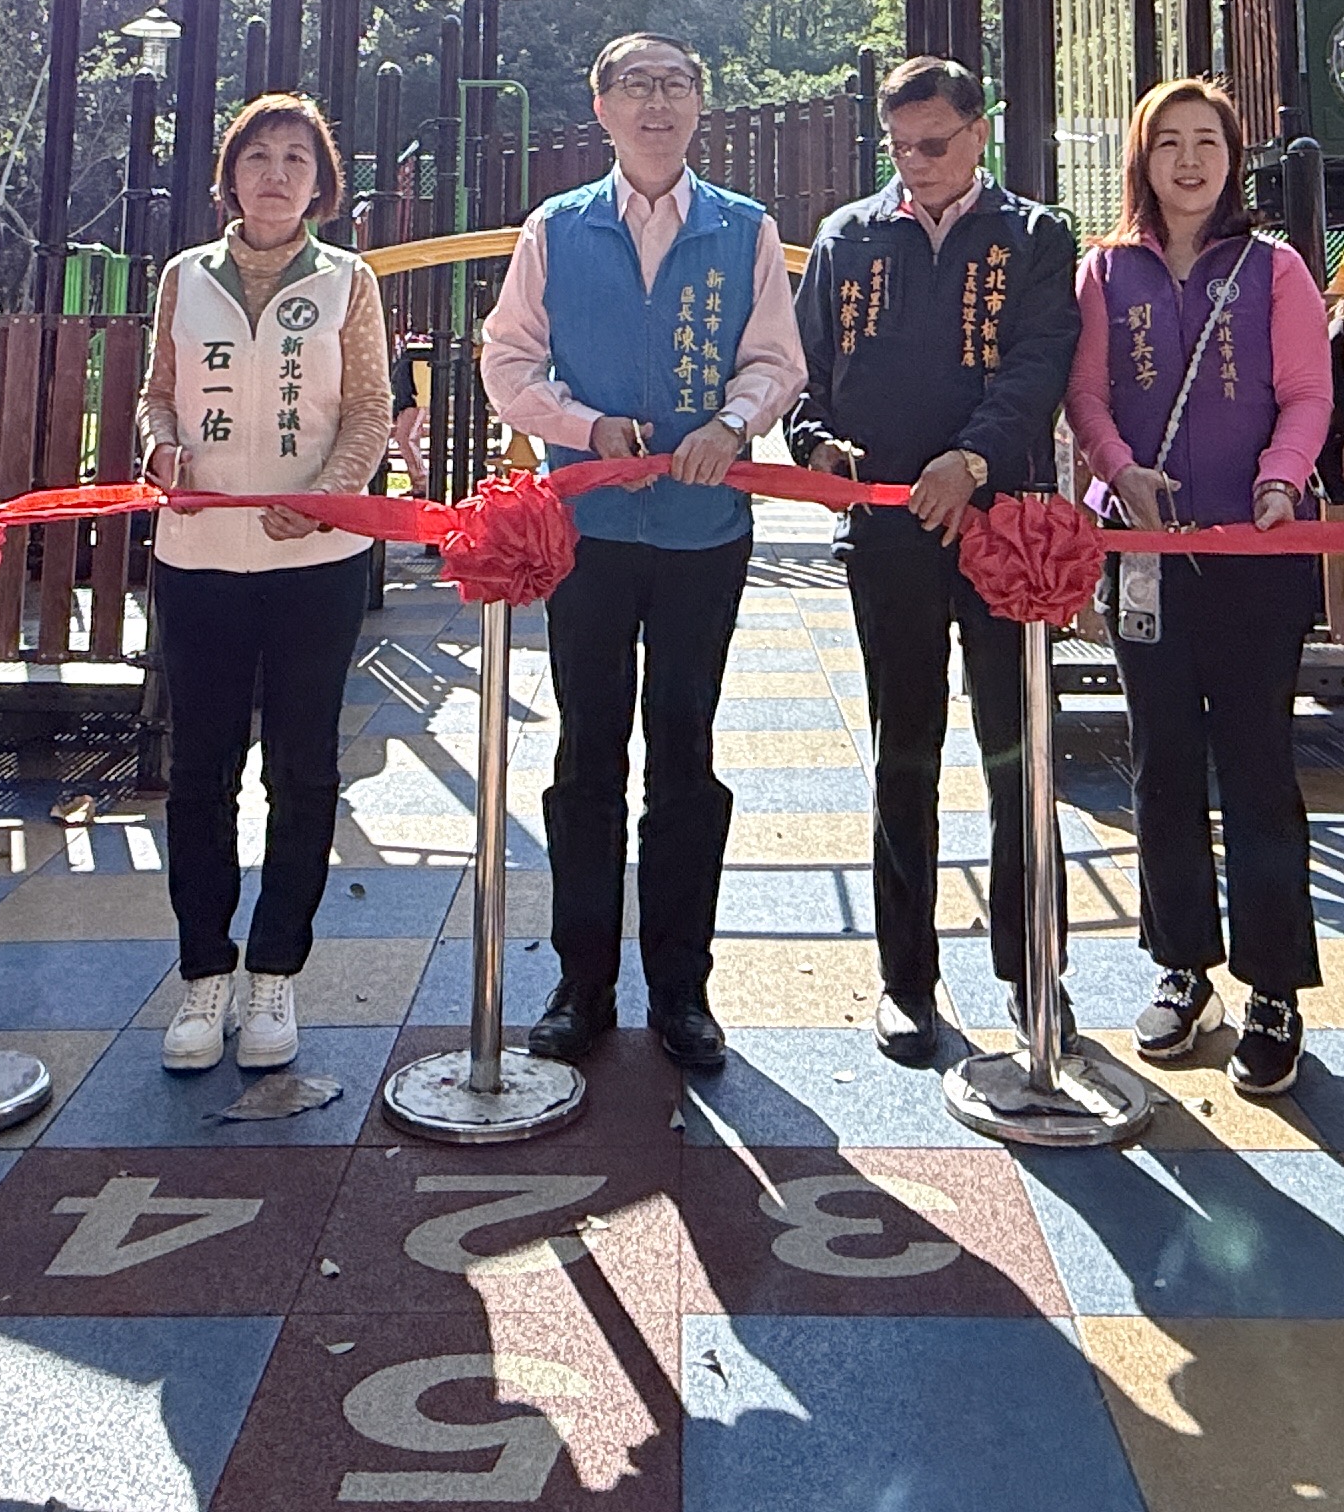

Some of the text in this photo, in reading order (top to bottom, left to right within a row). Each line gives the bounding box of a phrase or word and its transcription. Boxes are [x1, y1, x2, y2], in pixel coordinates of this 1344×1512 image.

[200, 340, 235, 443] 石一佑
[673, 286, 699, 414] 區長陳奇正
[700, 268, 726, 411] 新北市板橋區
[1126, 303, 1158, 390] 劉美芳
[1215, 309, 1239, 402] 新北市議員
[277, 336, 304, 458] 新北市議員
[43, 1176, 264, 1277] 4
[403, 1174, 609, 1276] 2
[757, 1173, 962, 1278] 3
[336, 1353, 593, 1504] 5
